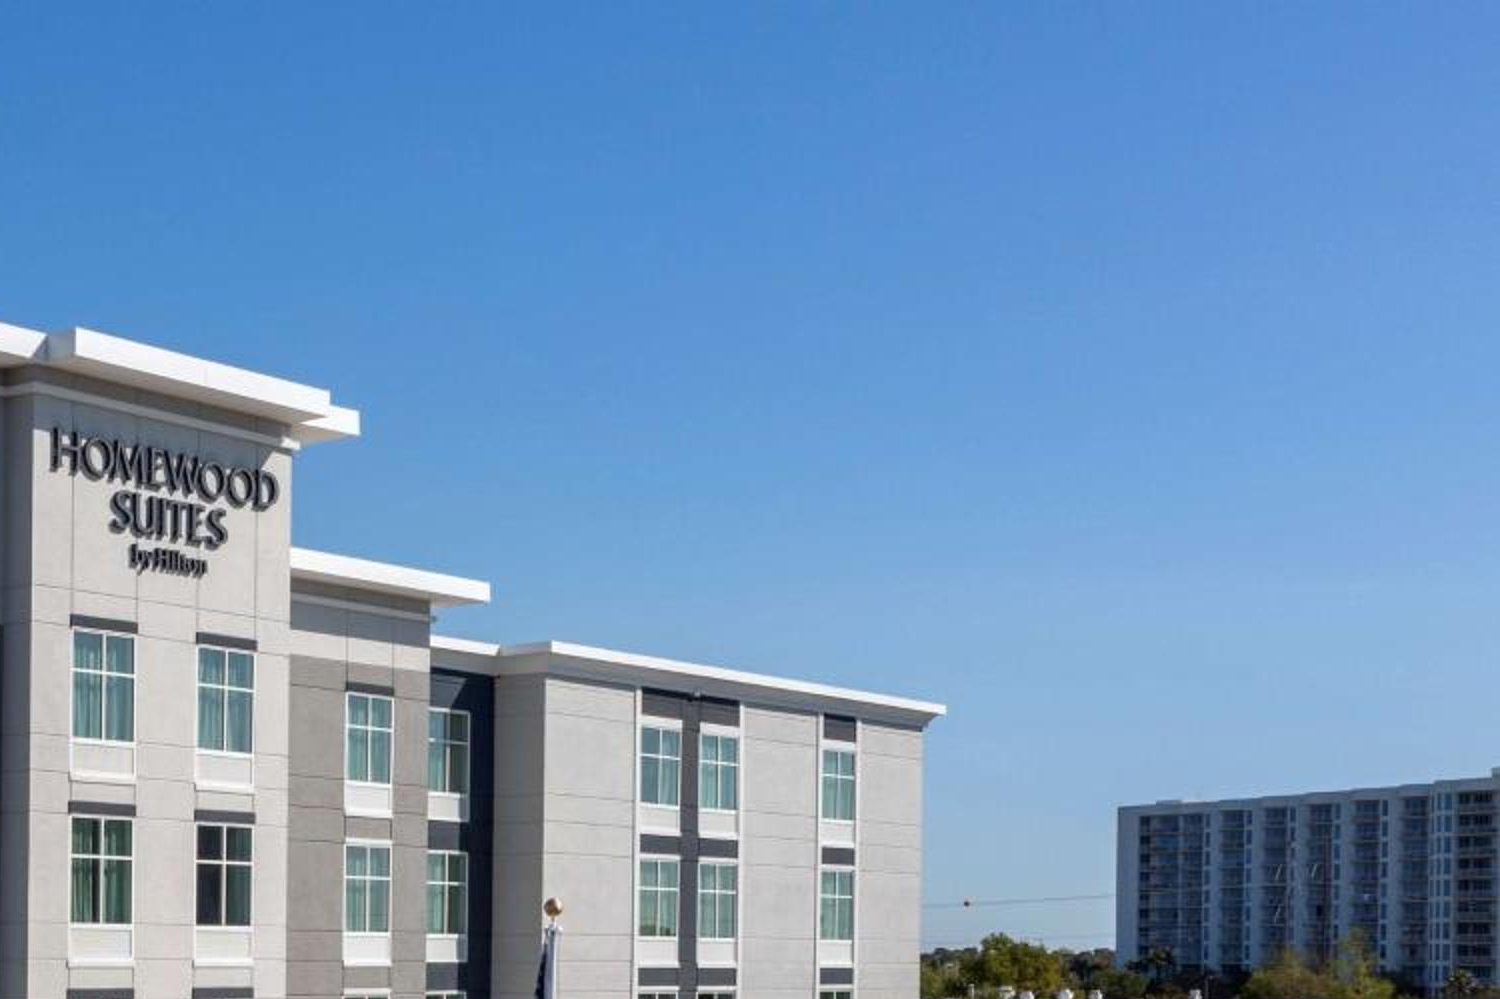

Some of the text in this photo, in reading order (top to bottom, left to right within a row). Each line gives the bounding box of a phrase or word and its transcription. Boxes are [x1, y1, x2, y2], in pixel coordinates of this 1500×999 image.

[50, 427, 280, 512] HOMEWOOD
[108, 490, 229, 550] SUITES
[129, 544, 208, 579] by Hilton
